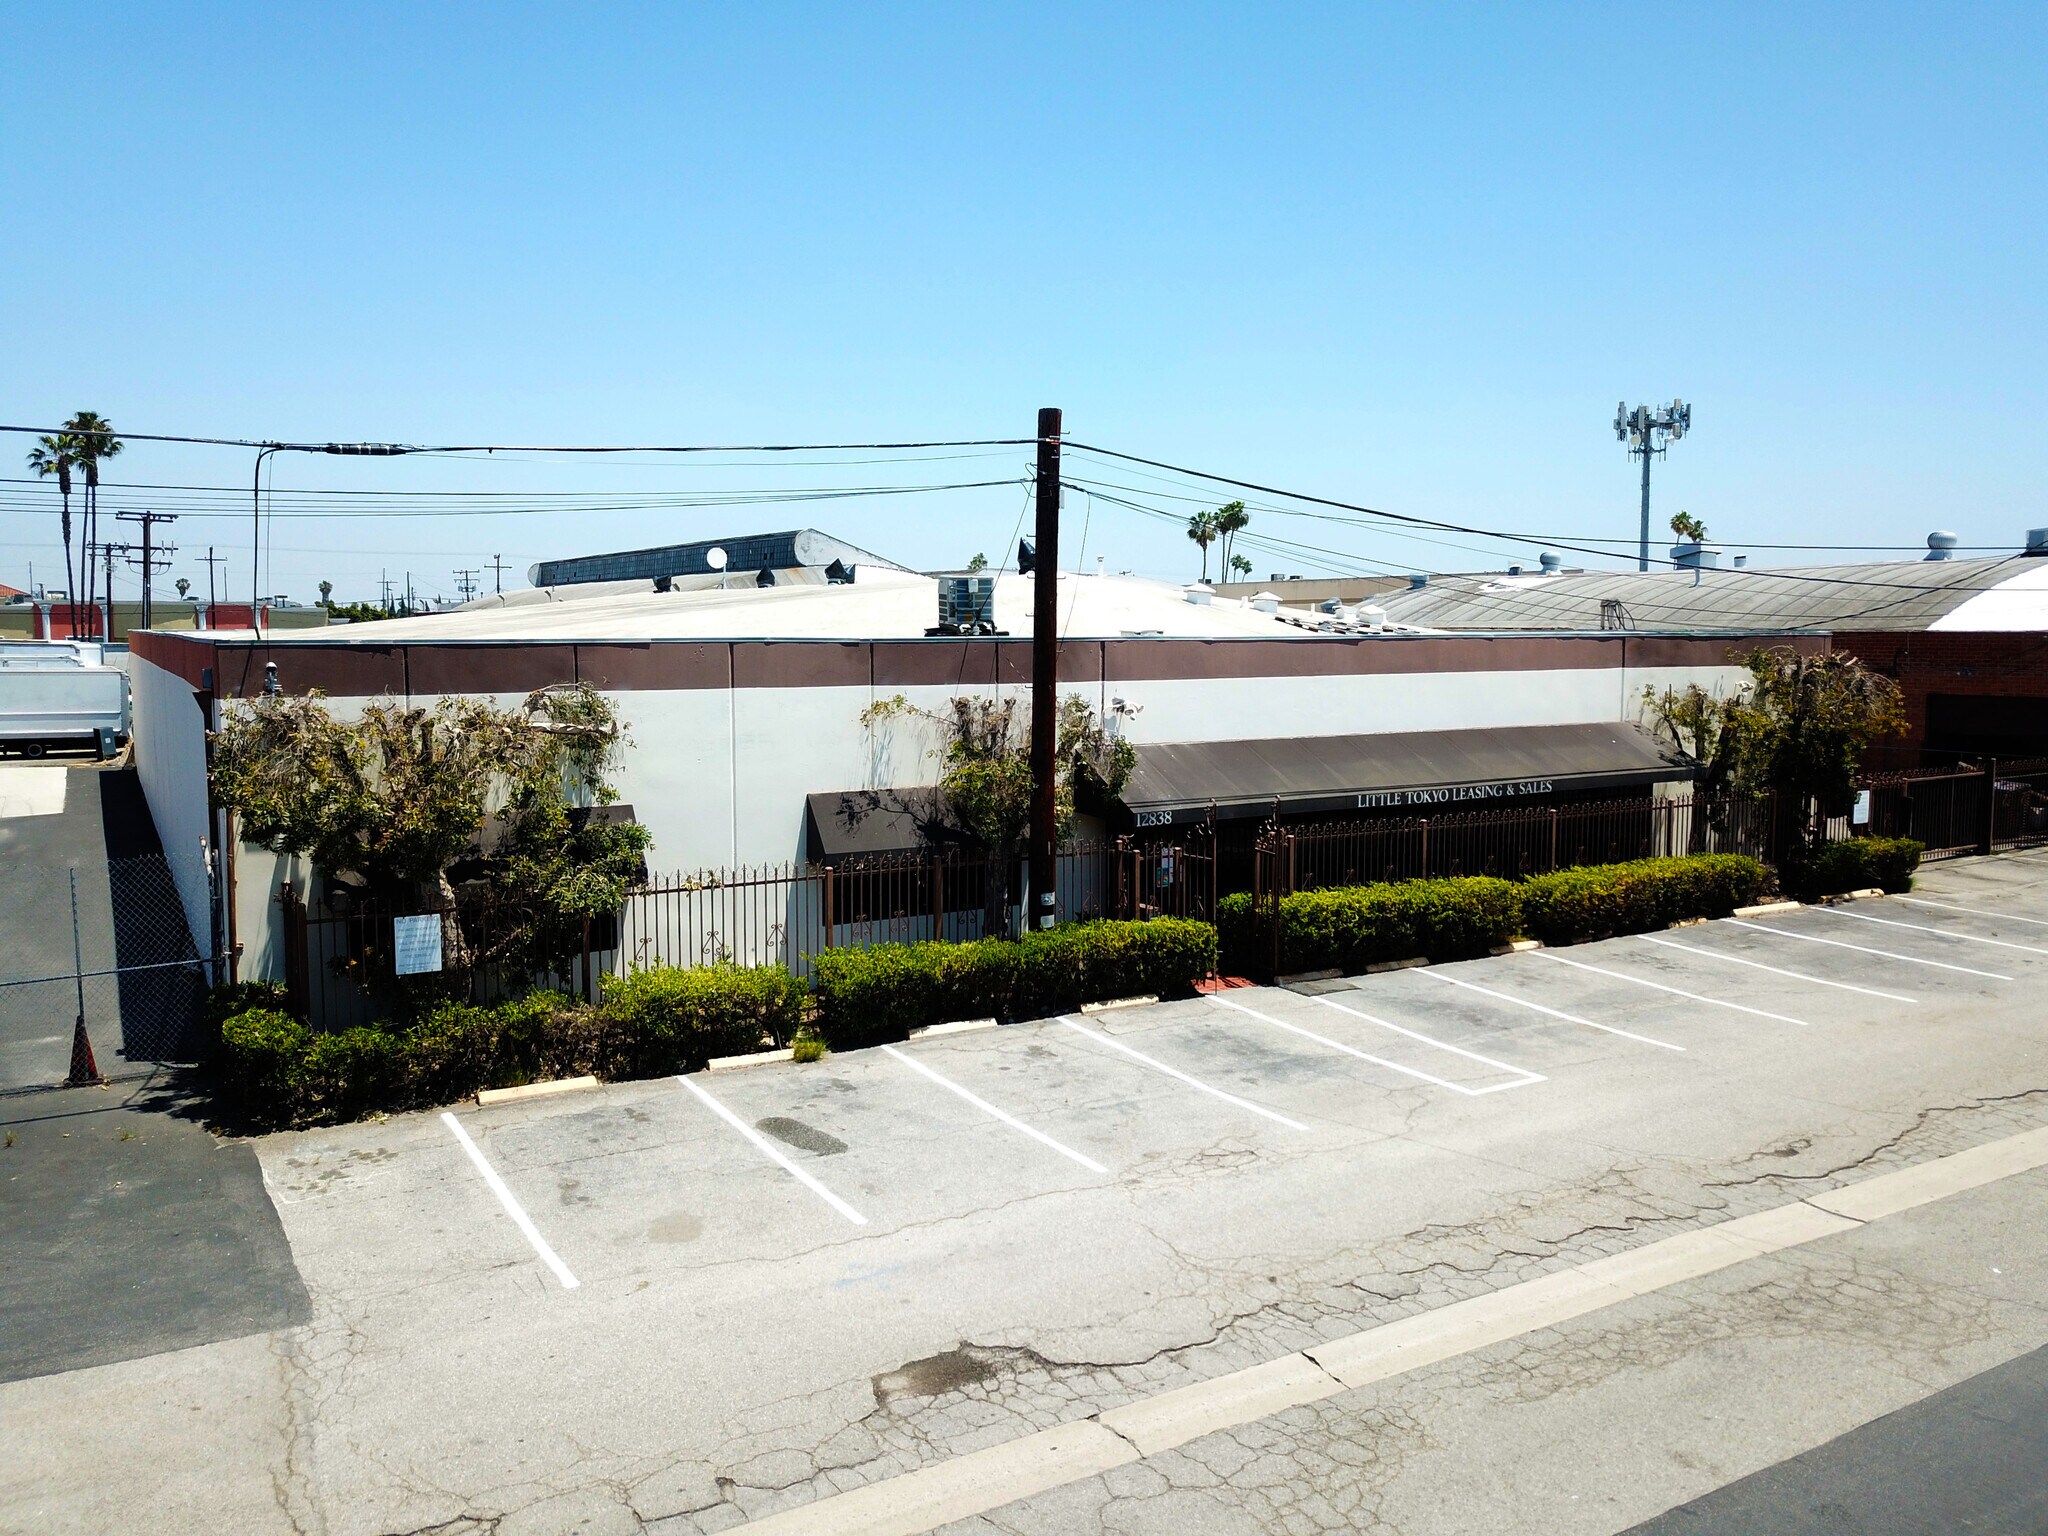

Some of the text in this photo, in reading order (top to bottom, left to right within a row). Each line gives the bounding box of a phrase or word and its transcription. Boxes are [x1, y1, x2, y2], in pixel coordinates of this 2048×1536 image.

[1357, 780, 1553, 808] LITTLE TOKYO LEASING & SALES
[1136, 811, 1172, 827] 12838
